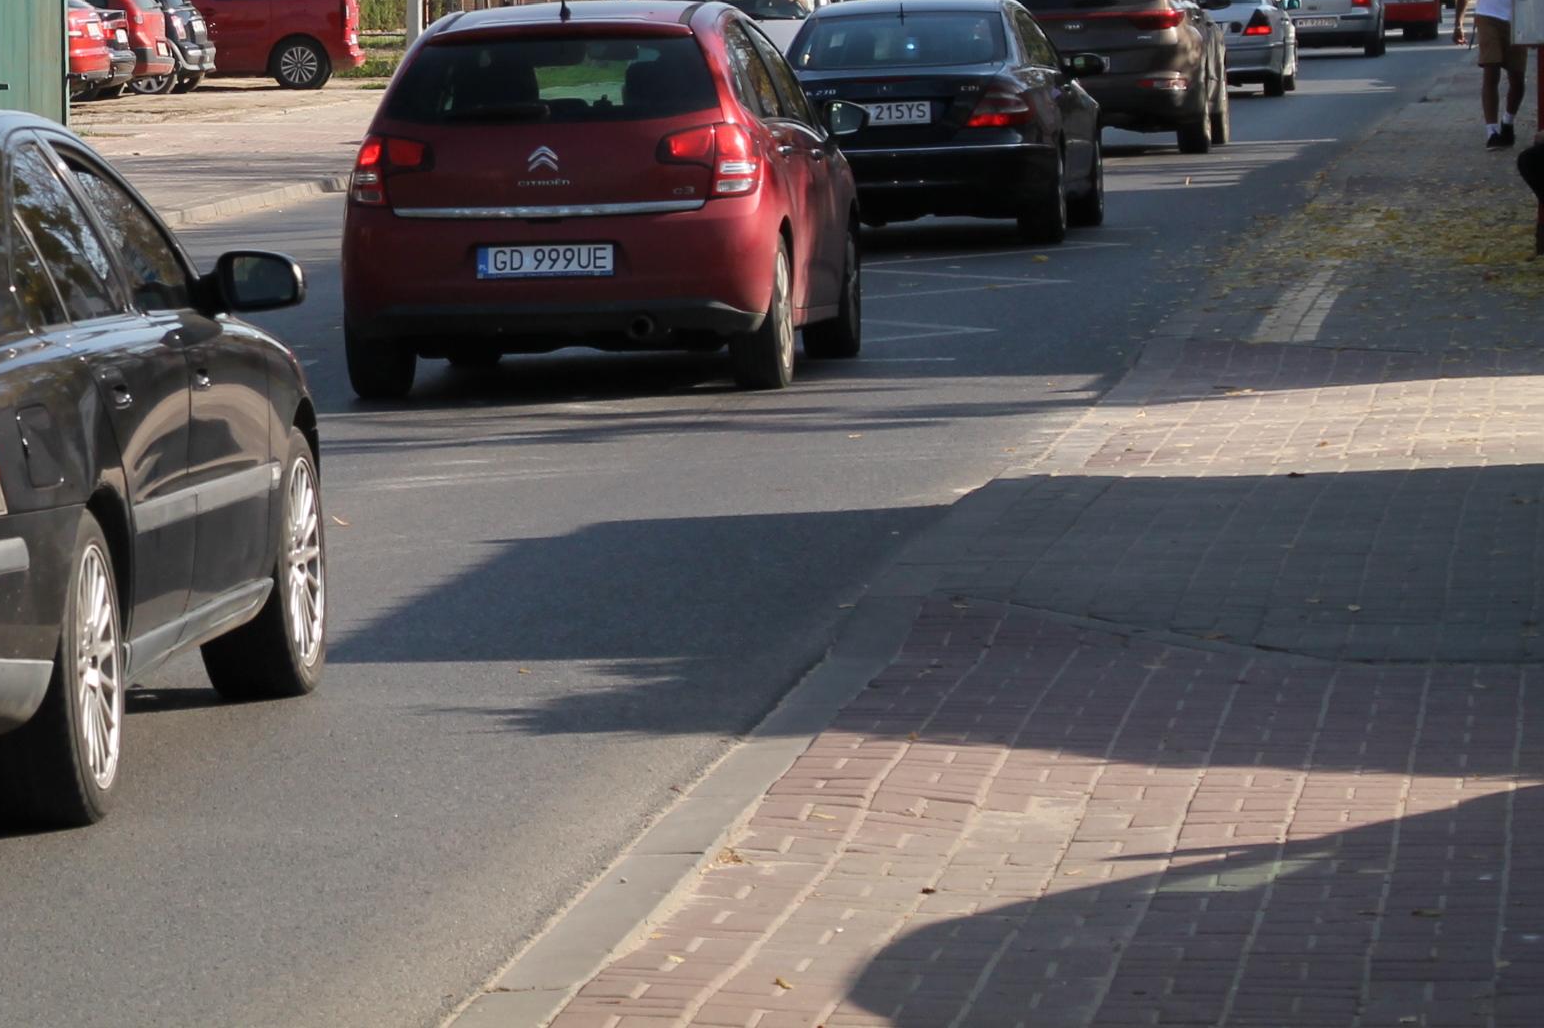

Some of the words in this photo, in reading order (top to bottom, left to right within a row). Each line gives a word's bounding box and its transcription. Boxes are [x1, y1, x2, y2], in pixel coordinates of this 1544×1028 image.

[875, 103, 927, 121] 215YS
[494, 249, 524, 271] GD
[533, 247, 607, 271] 999UE
